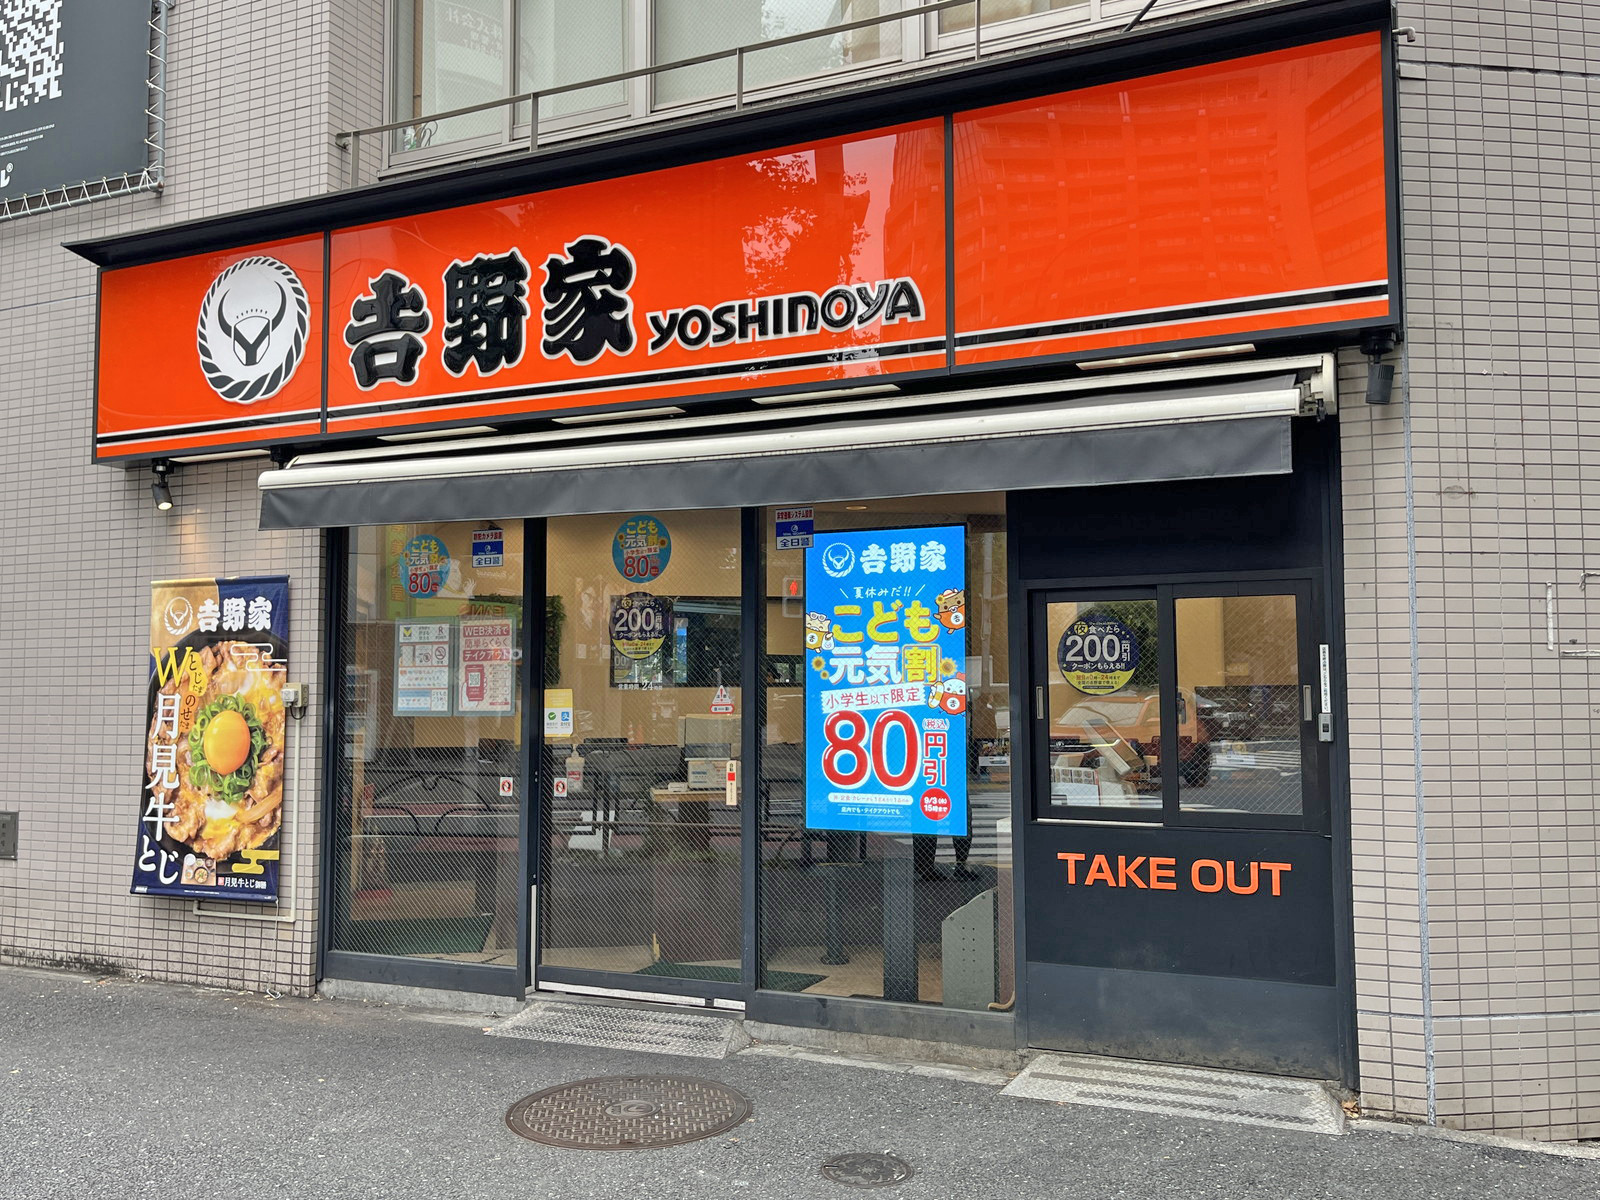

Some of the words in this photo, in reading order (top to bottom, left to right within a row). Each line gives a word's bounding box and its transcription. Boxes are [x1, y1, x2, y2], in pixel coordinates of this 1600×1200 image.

[343, 235, 637, 391] 吉野家
[647, 277, 926, 357] YOSHINOYA
[626, 520, 658, 534] こども
[411, 540, 439, 552] こども
[780, 538, 809, 547] 全日警
[624, 555, 649, 577] 80
[860, 541, 947, 575] 吉野家
[409, 572, 432, 593] 80
[197, 596, 272, 632] 吉野家
[614, 607, 655, 632] 200
[832, 599, 940, 643] こども
[464, 624, 509, 637] WEB決済で
[464, 650, 511, 661] テイクアウト
[1065, 634, 1120, 662] 200
[829, 644, 941, 685] 元気割
[826, 687, 921, 710] 小学生以下限定
[822, 709, 921, 790] 80
[923, 731, 947, 786] 円引
[1057, 852, 1177, 891] TAKE
[1191, 859, 1292, 897] OUT
